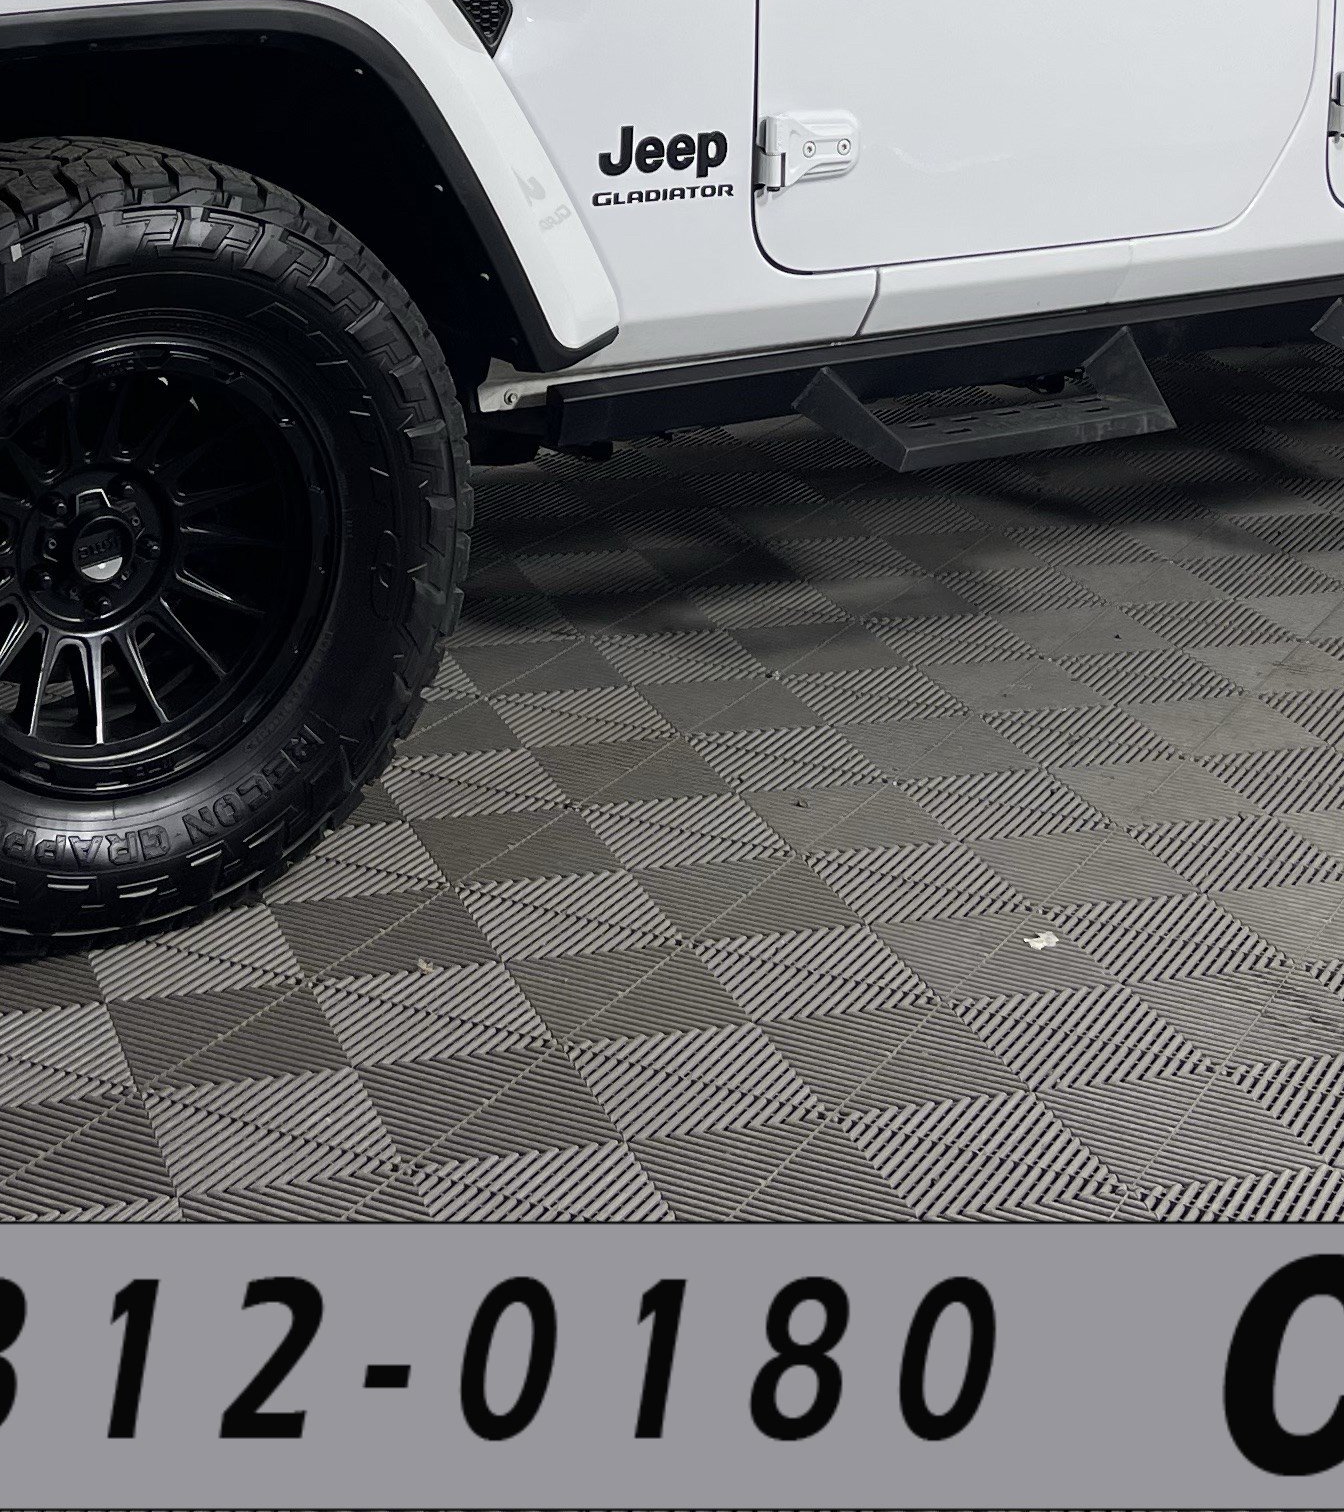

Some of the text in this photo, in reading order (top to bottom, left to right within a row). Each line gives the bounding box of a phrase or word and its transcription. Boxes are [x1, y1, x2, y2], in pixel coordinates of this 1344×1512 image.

[598, 125, 728, 179] Jeep
[592, 184, 734, 207] GLADIATOR
[182, 725, 326, 846] RECON
